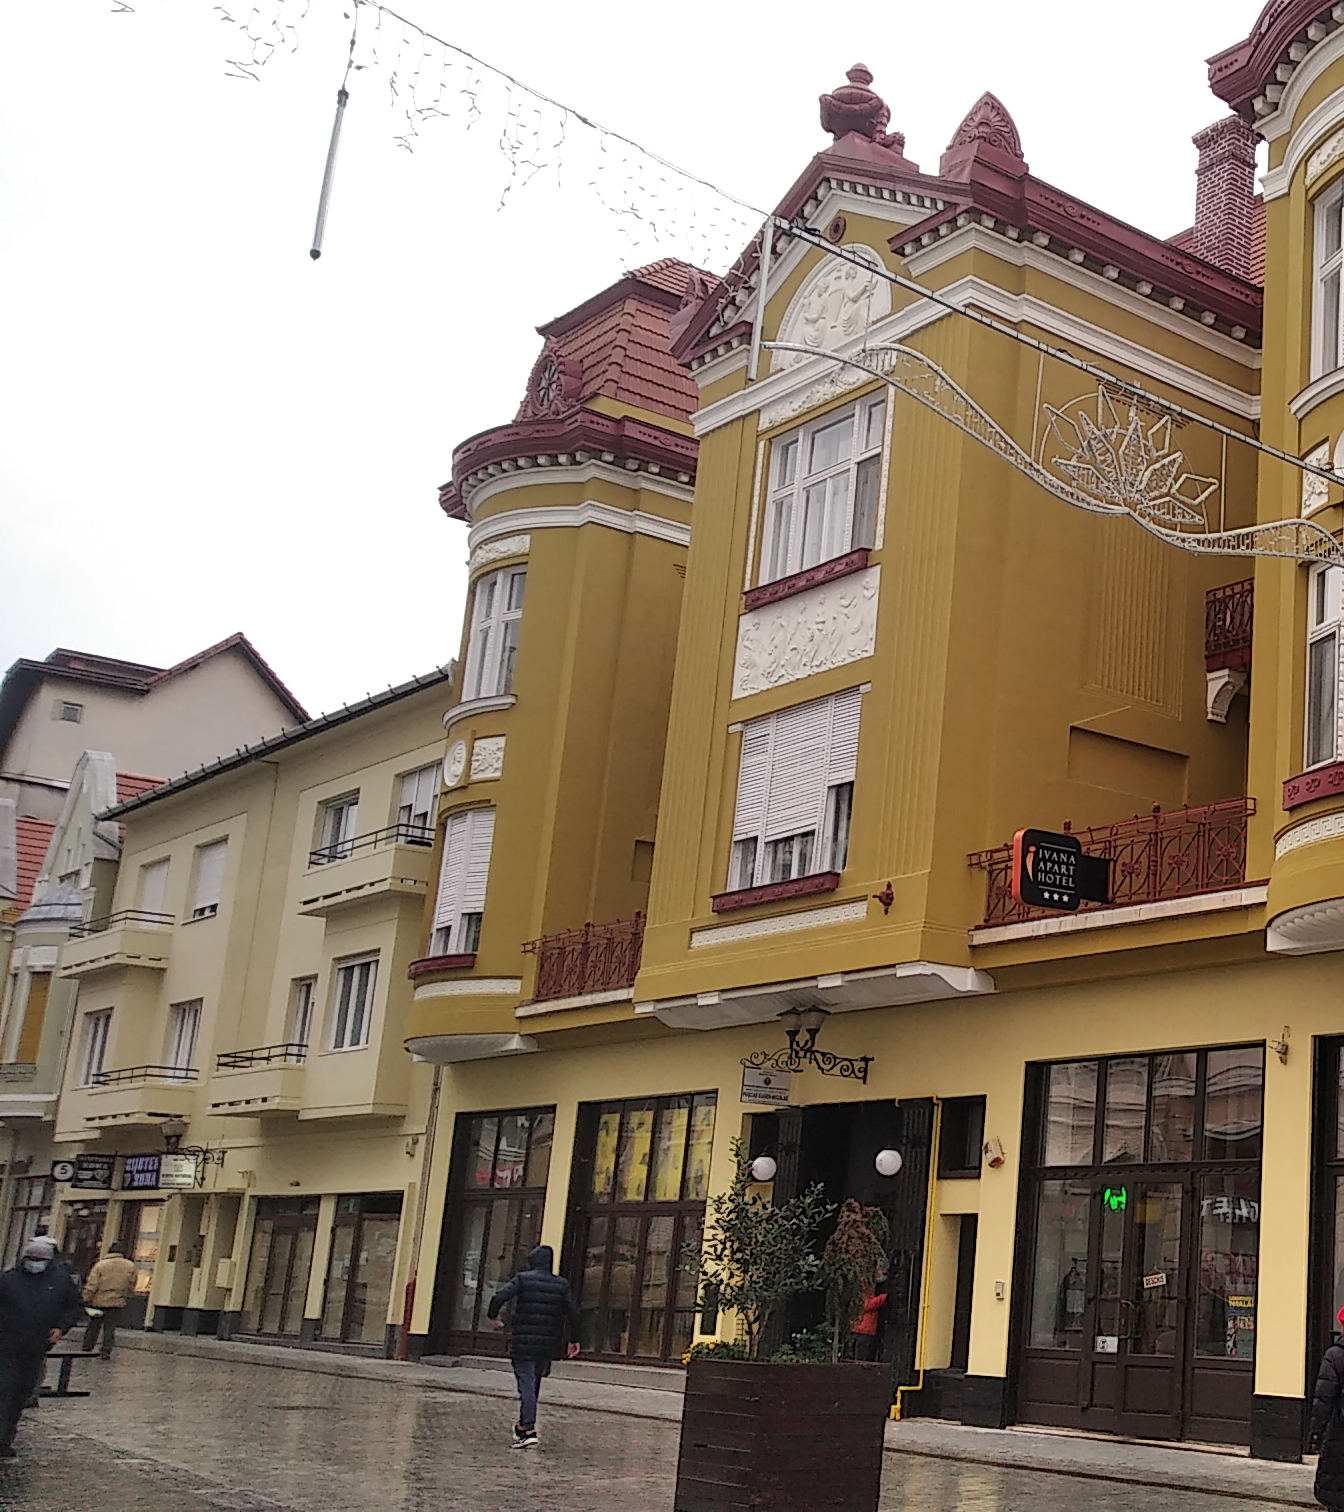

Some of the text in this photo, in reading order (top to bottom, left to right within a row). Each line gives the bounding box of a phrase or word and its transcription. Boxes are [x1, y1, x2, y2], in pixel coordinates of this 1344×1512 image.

[1039, 849, 1076, 864] IVANA
[1037, 861, 1076, 876] APART
[1037, 872, 1075, 887] HOTEL
[1146, 1275, 1164, 1286] DESCHIS
